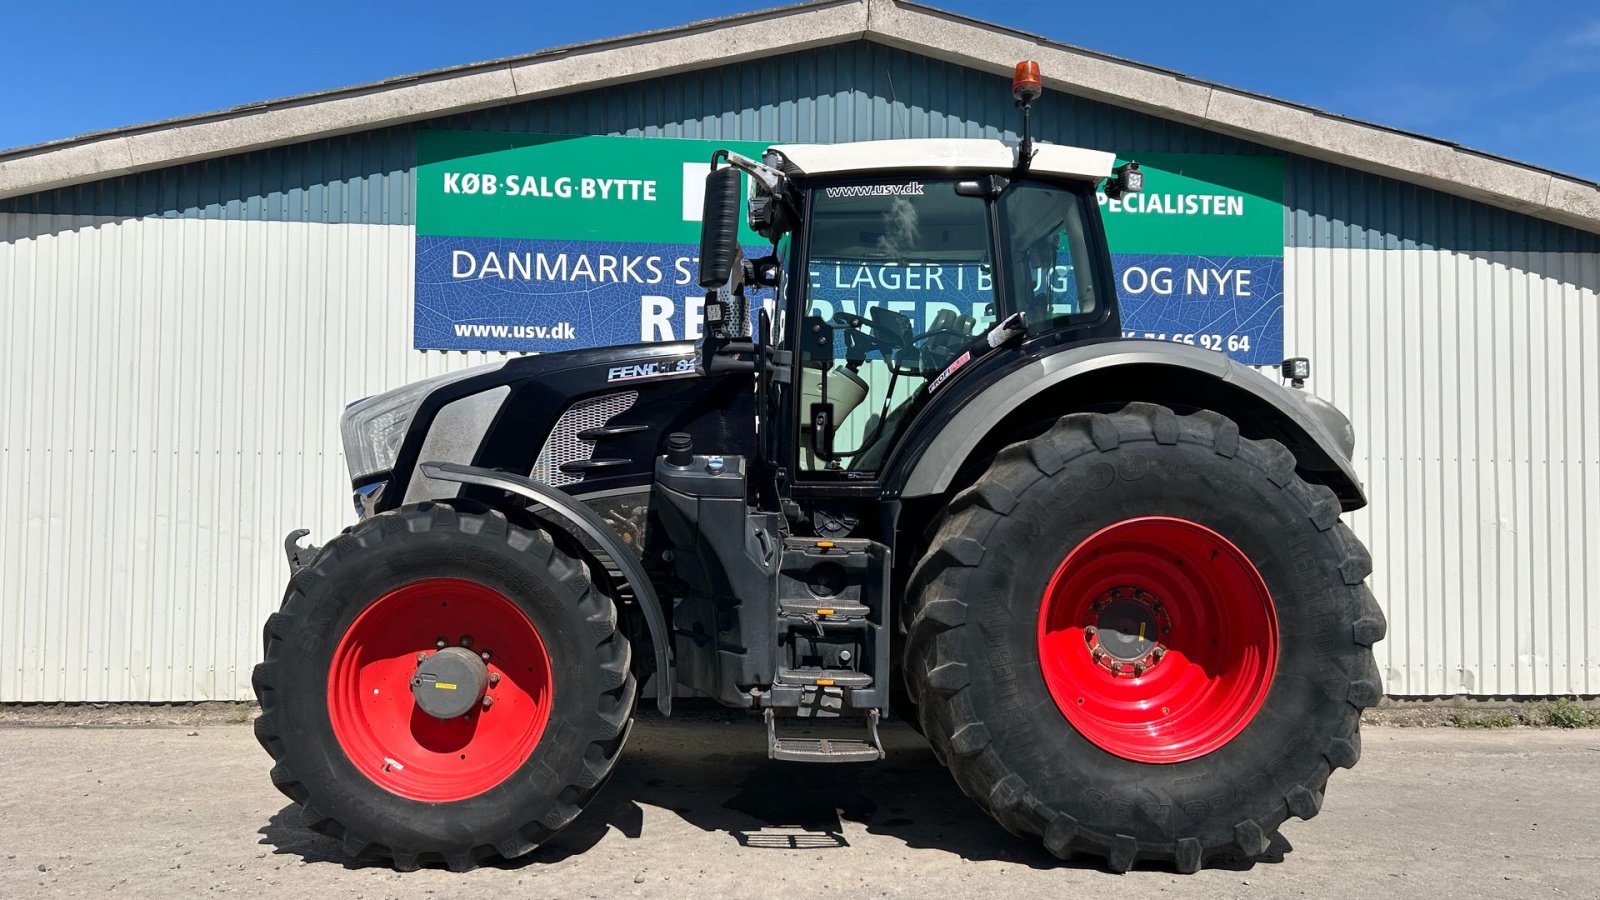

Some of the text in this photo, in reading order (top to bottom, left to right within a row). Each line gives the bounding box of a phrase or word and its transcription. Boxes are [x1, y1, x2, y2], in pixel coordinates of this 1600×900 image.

[826, 181, 925, 198] www.usv.dk
[1096, 191, 1244, 216] PECIALISTEN
[452, 250, 663, 285] DANMARKS
[835, 261, 944, 291] LAGER
[1122, 266, 1173, 295] OG
[1187, 268, 1251, 297] NYE
[454, 322, 576, 340] www.usv.dk
[1200, 334, 1223, 352] 92
[1228, 335, 1250, 352] 64
